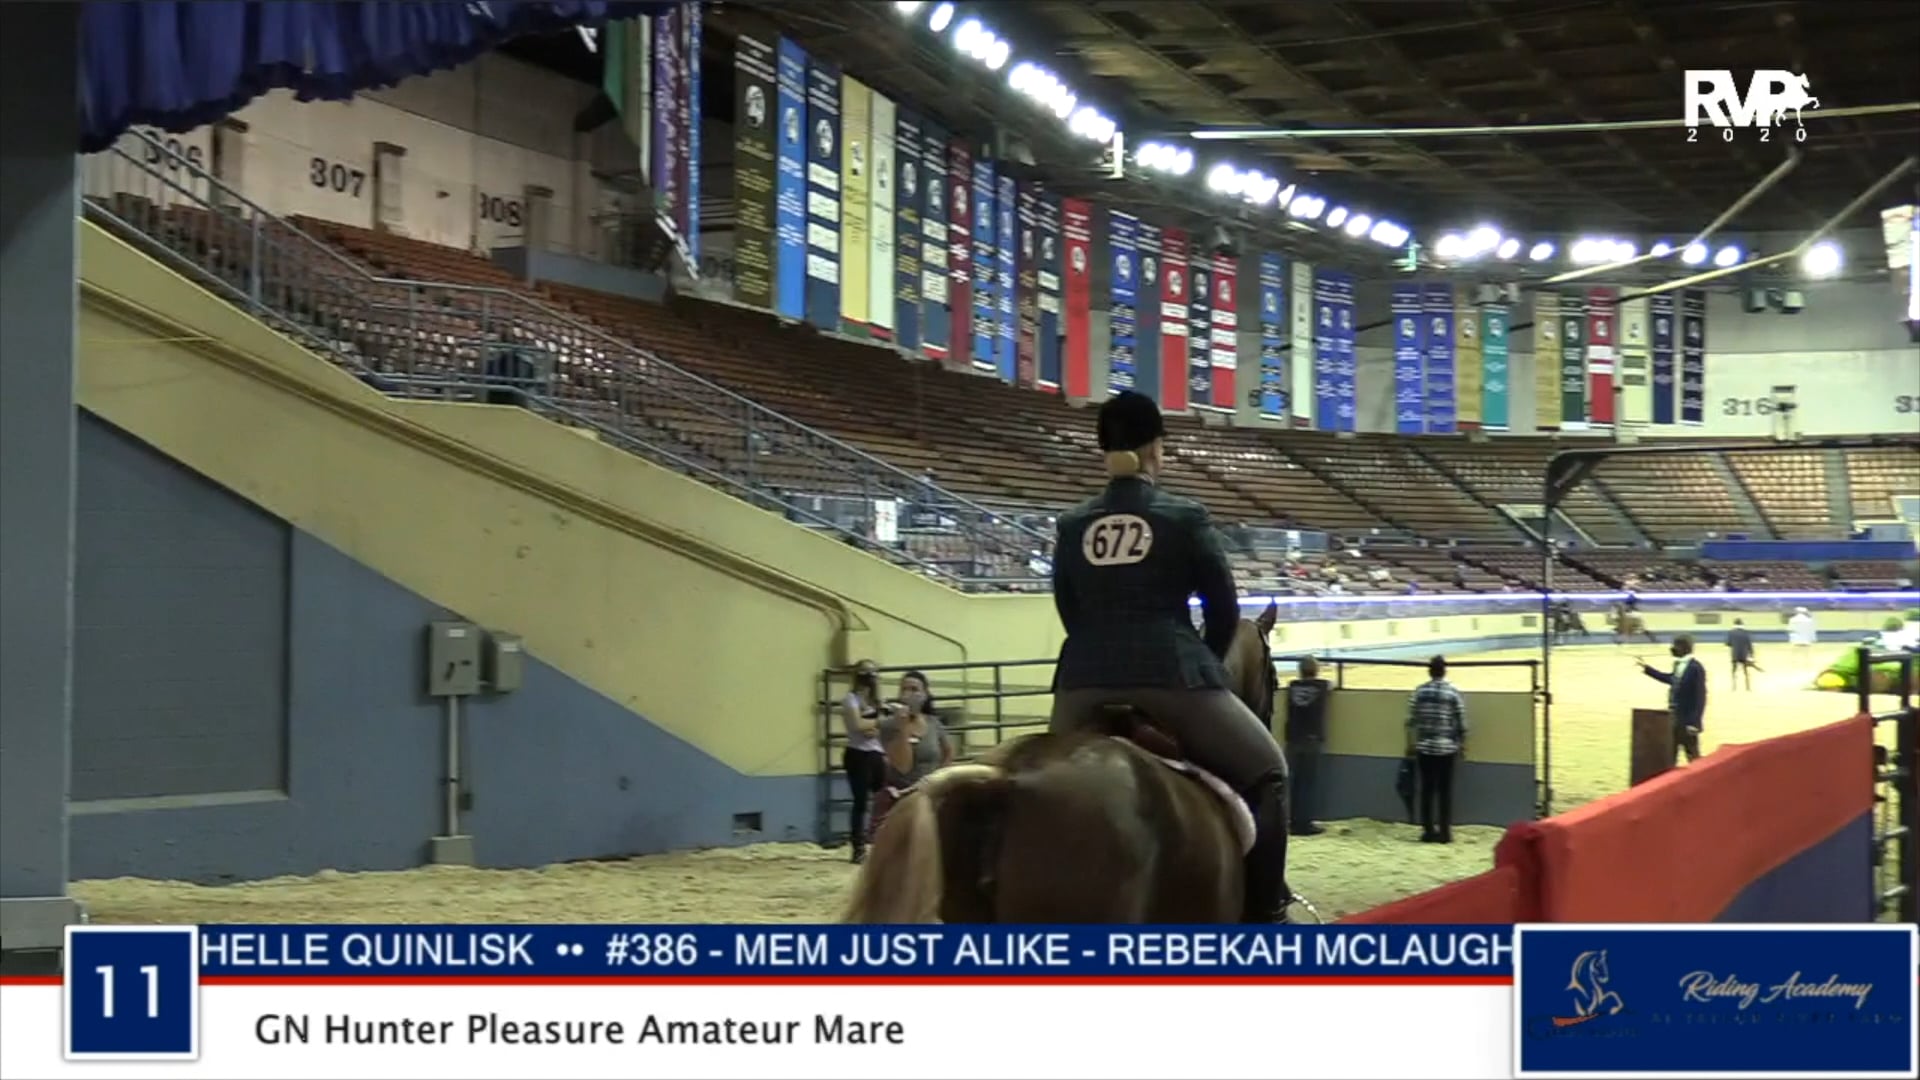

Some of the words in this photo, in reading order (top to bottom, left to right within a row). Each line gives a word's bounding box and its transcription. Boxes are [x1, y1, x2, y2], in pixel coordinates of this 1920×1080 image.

[309, 157, 366, 198] 307
[1722, 397, 1772, 416] 316
[1093, 521, 1143, 559] 672
